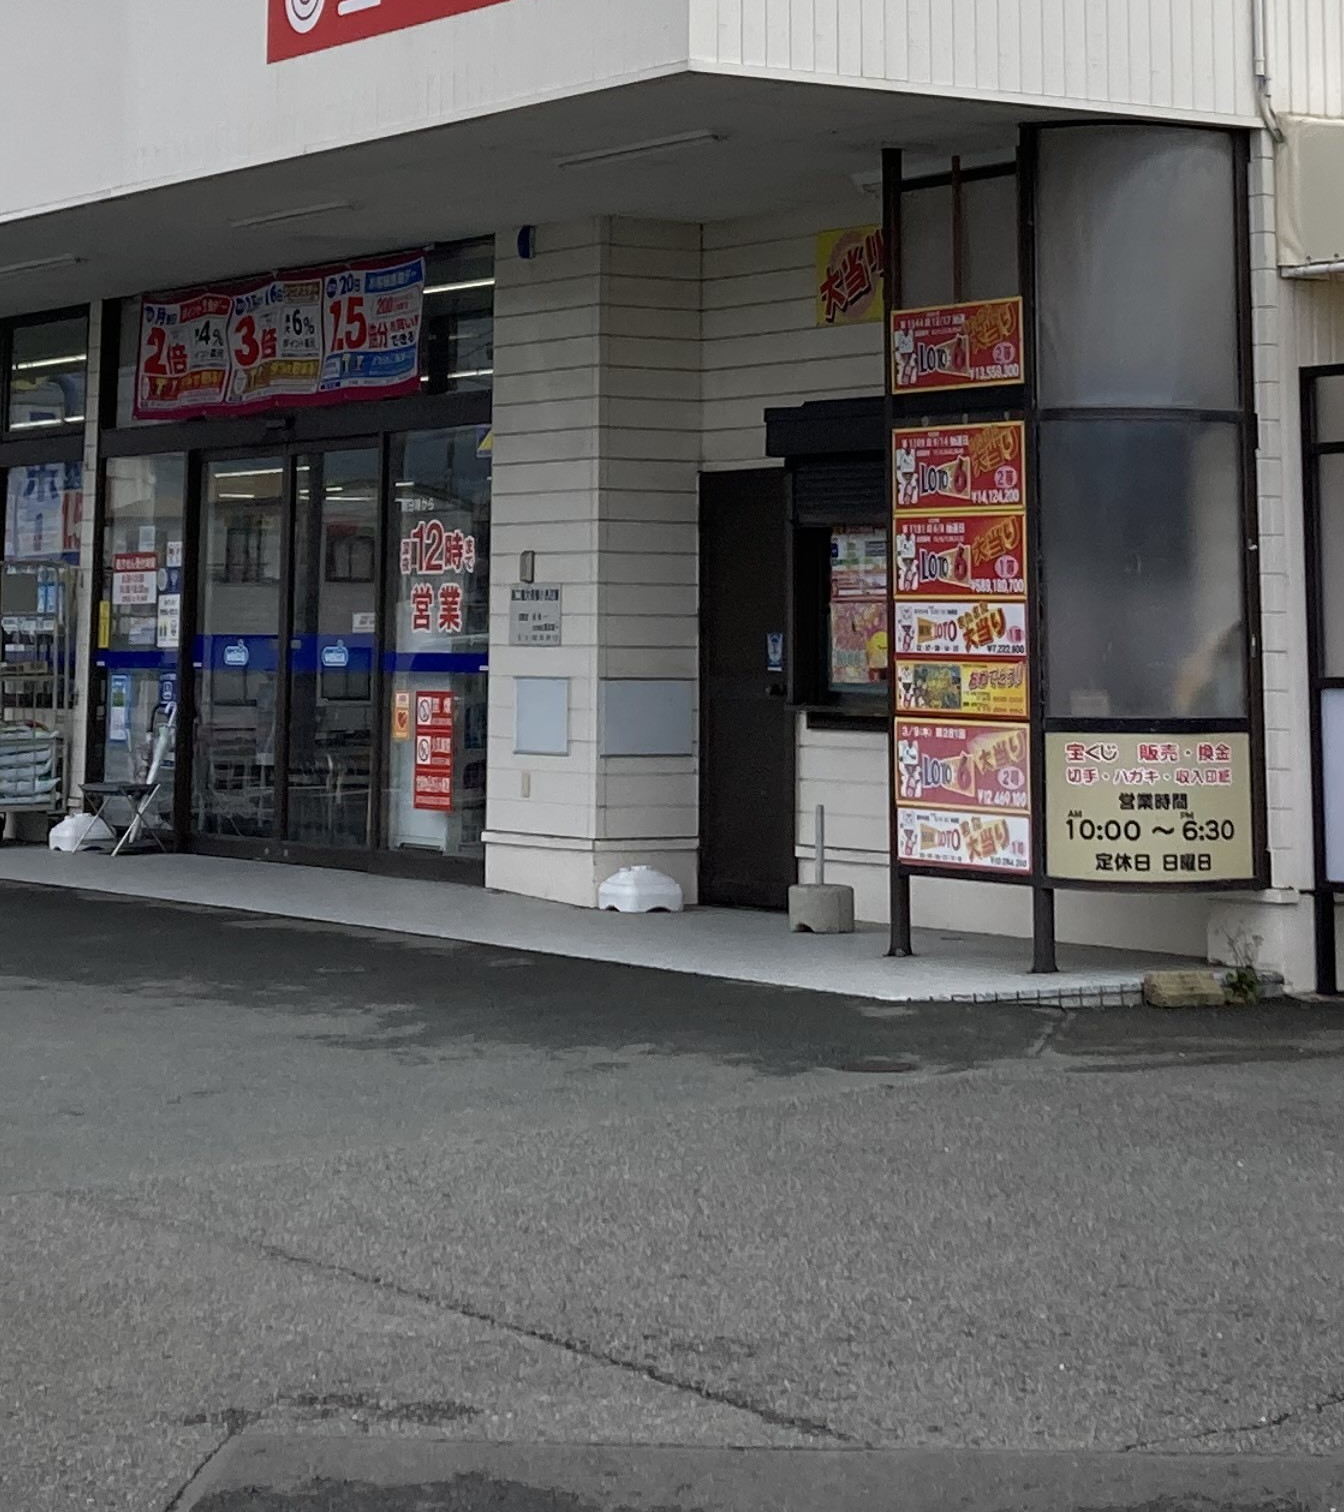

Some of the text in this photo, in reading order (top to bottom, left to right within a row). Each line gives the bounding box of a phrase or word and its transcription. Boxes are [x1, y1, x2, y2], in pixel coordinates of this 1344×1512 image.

[412, 584, 461, 632] 営業
[1066, 743, 1118, 762] 宝くじ
[1118, 792, 1189, 811] 営業時間
[1095, 853, 1212, 873] 定休日 日曜日
